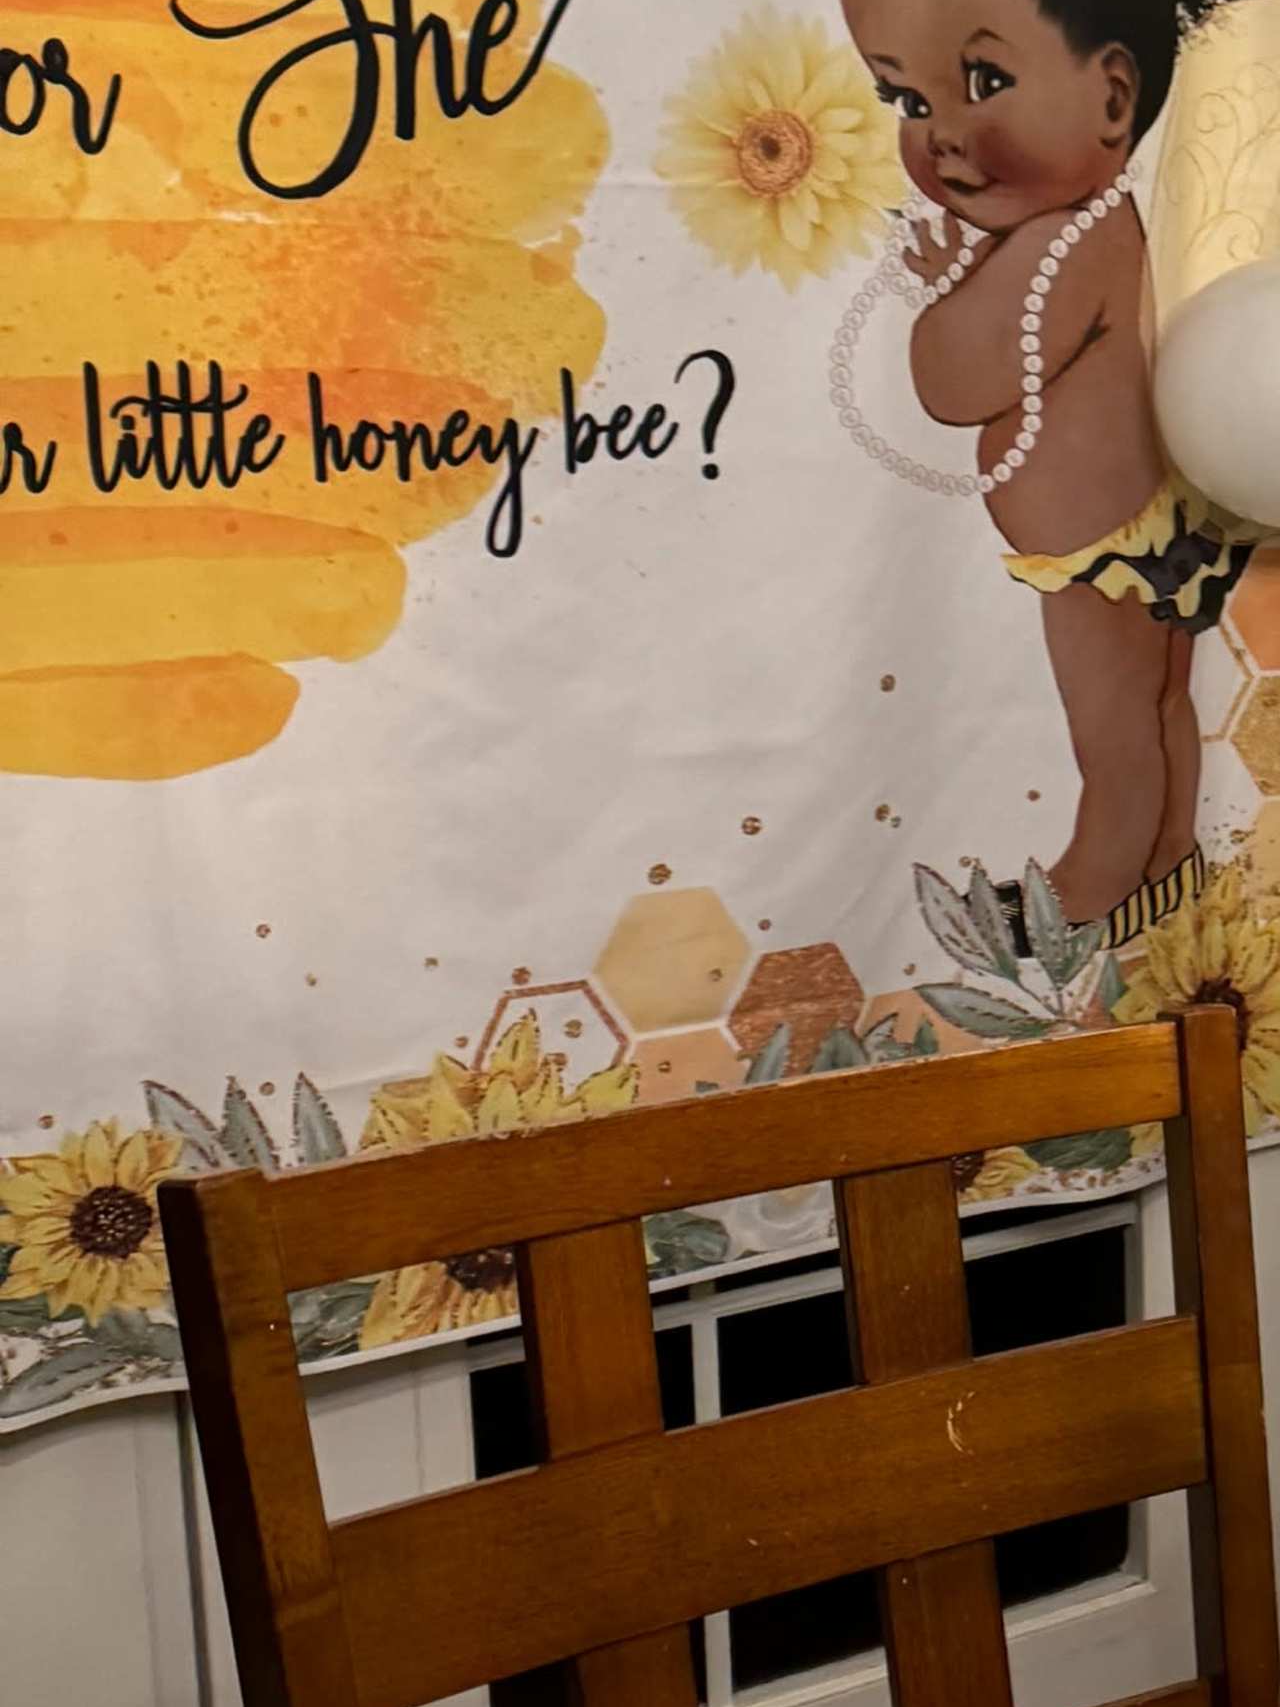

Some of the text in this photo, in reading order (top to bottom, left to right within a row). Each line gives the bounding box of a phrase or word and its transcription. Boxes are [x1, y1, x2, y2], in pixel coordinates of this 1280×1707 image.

[83, 359, 286, 494] little
[306, 370, 539, 558] honey
[560, 348, 737, 482] bee?
